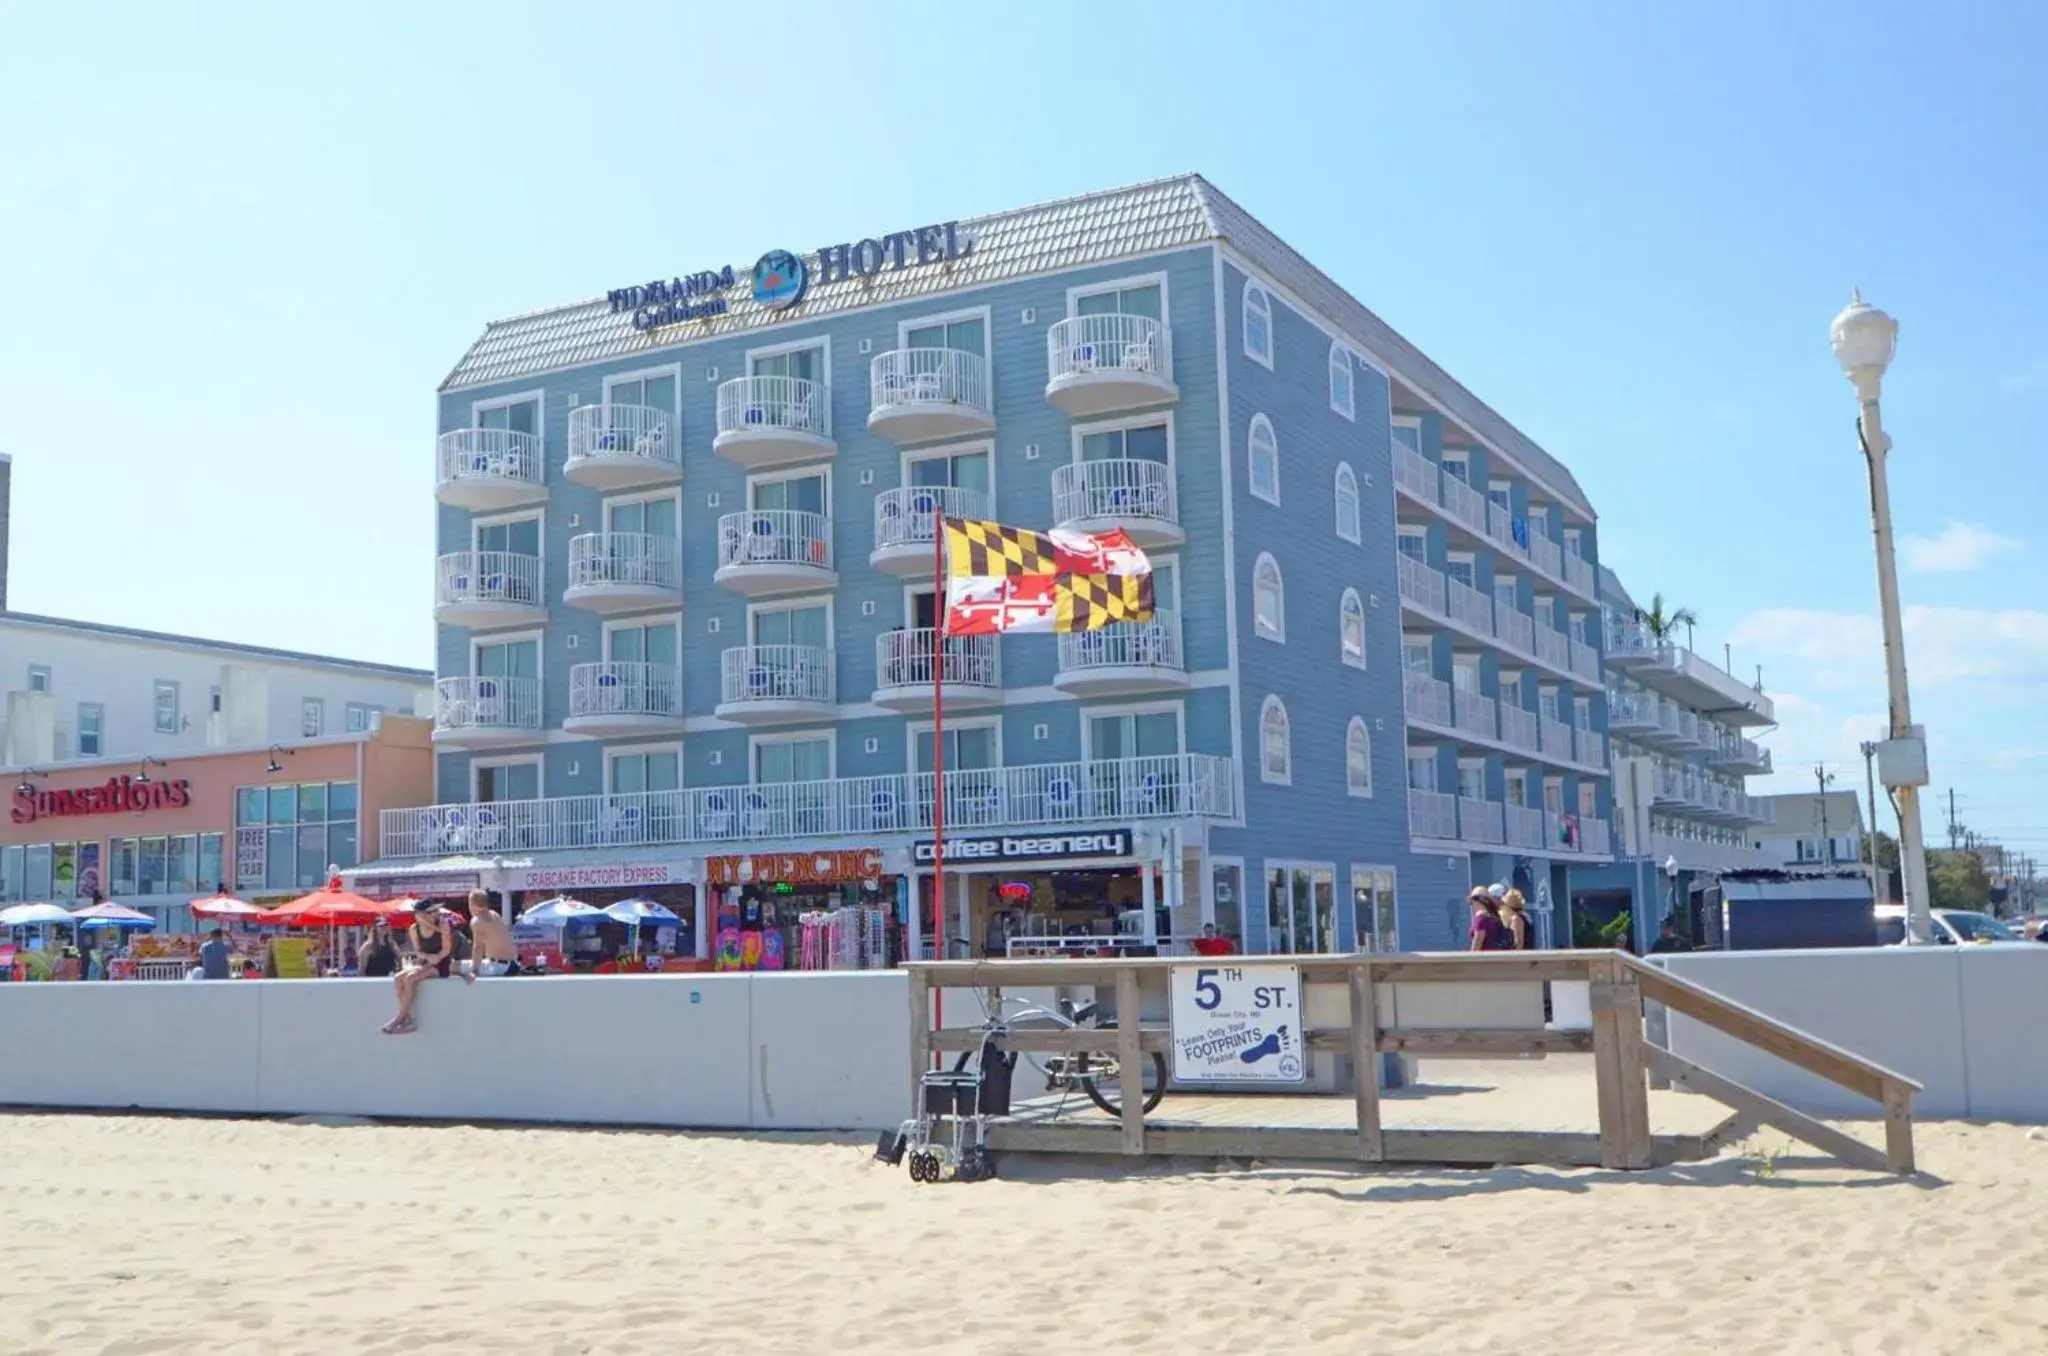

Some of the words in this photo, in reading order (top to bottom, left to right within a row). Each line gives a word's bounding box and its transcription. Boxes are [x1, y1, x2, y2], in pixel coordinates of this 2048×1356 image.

[607, 264, 735, 313] TIDELANDS
[817, 220, 974, 284] HOTEL
[10, 775, 190, 823] Sunsations
[1002, 833, 1124, 855] beanery
[526, 871, 577, 888] CRABCAKE
[579, 868, 621, 885] FACTORY
[623, 866, 668, 883] EXPRESS
[750, 848, 885, 884] PIERCING
[1254, 986, 1292, 1009] ST.
[1184, 1027, 1263, 1062] FOOTPRINTS
